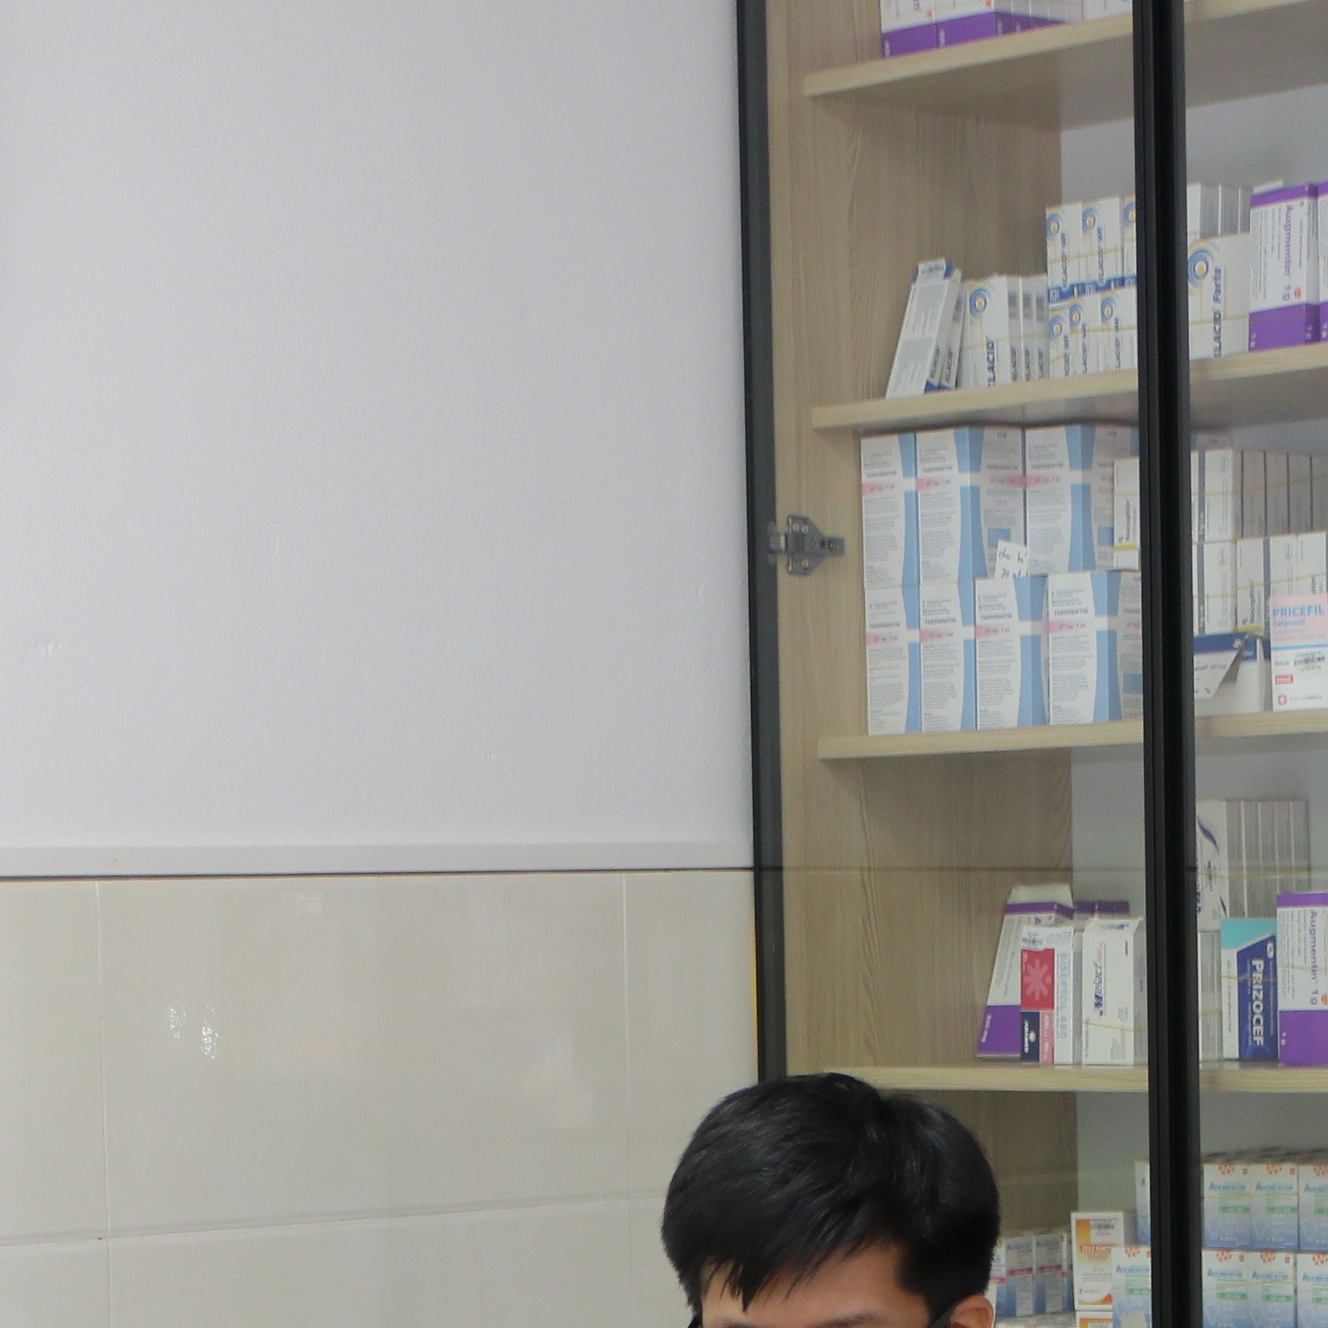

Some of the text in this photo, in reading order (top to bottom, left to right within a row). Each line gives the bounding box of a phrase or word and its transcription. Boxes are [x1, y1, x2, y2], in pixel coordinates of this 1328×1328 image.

[1282, 205, 1294, 277] Augmentin
[1272, 604, 1325, 618] PRICEFIL
[1309, 910, 1318, 979] Augmentin
[1250, 957, 1265, 1048] PRIZOCEF
